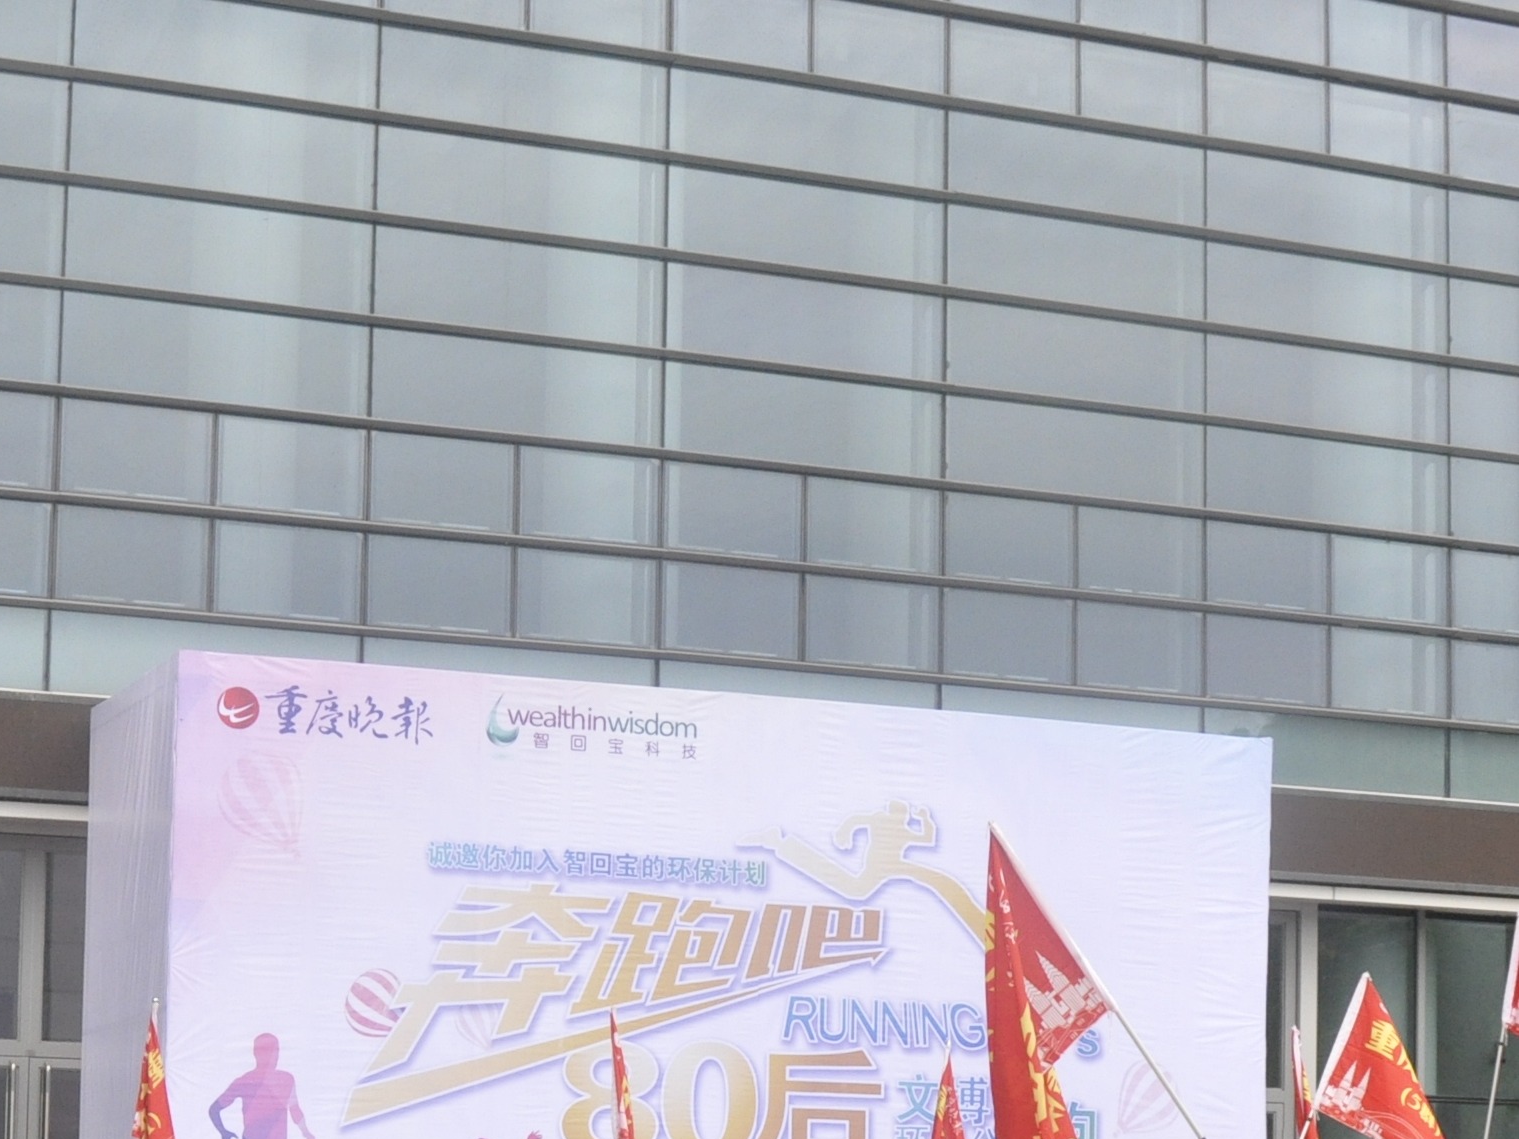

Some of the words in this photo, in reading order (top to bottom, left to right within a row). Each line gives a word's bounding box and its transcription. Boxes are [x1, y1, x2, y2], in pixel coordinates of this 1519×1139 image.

[507, 704, 698, 739] wealthinwisdom
[533, 732, 697, 760] 智回宝科技
[428, 841, 768, 887] 诚邀你加入智回宝的环保计划
[360, 882, 886, 1082] 奔跑吧
[782, 995, 986, 1051] RUNNING
